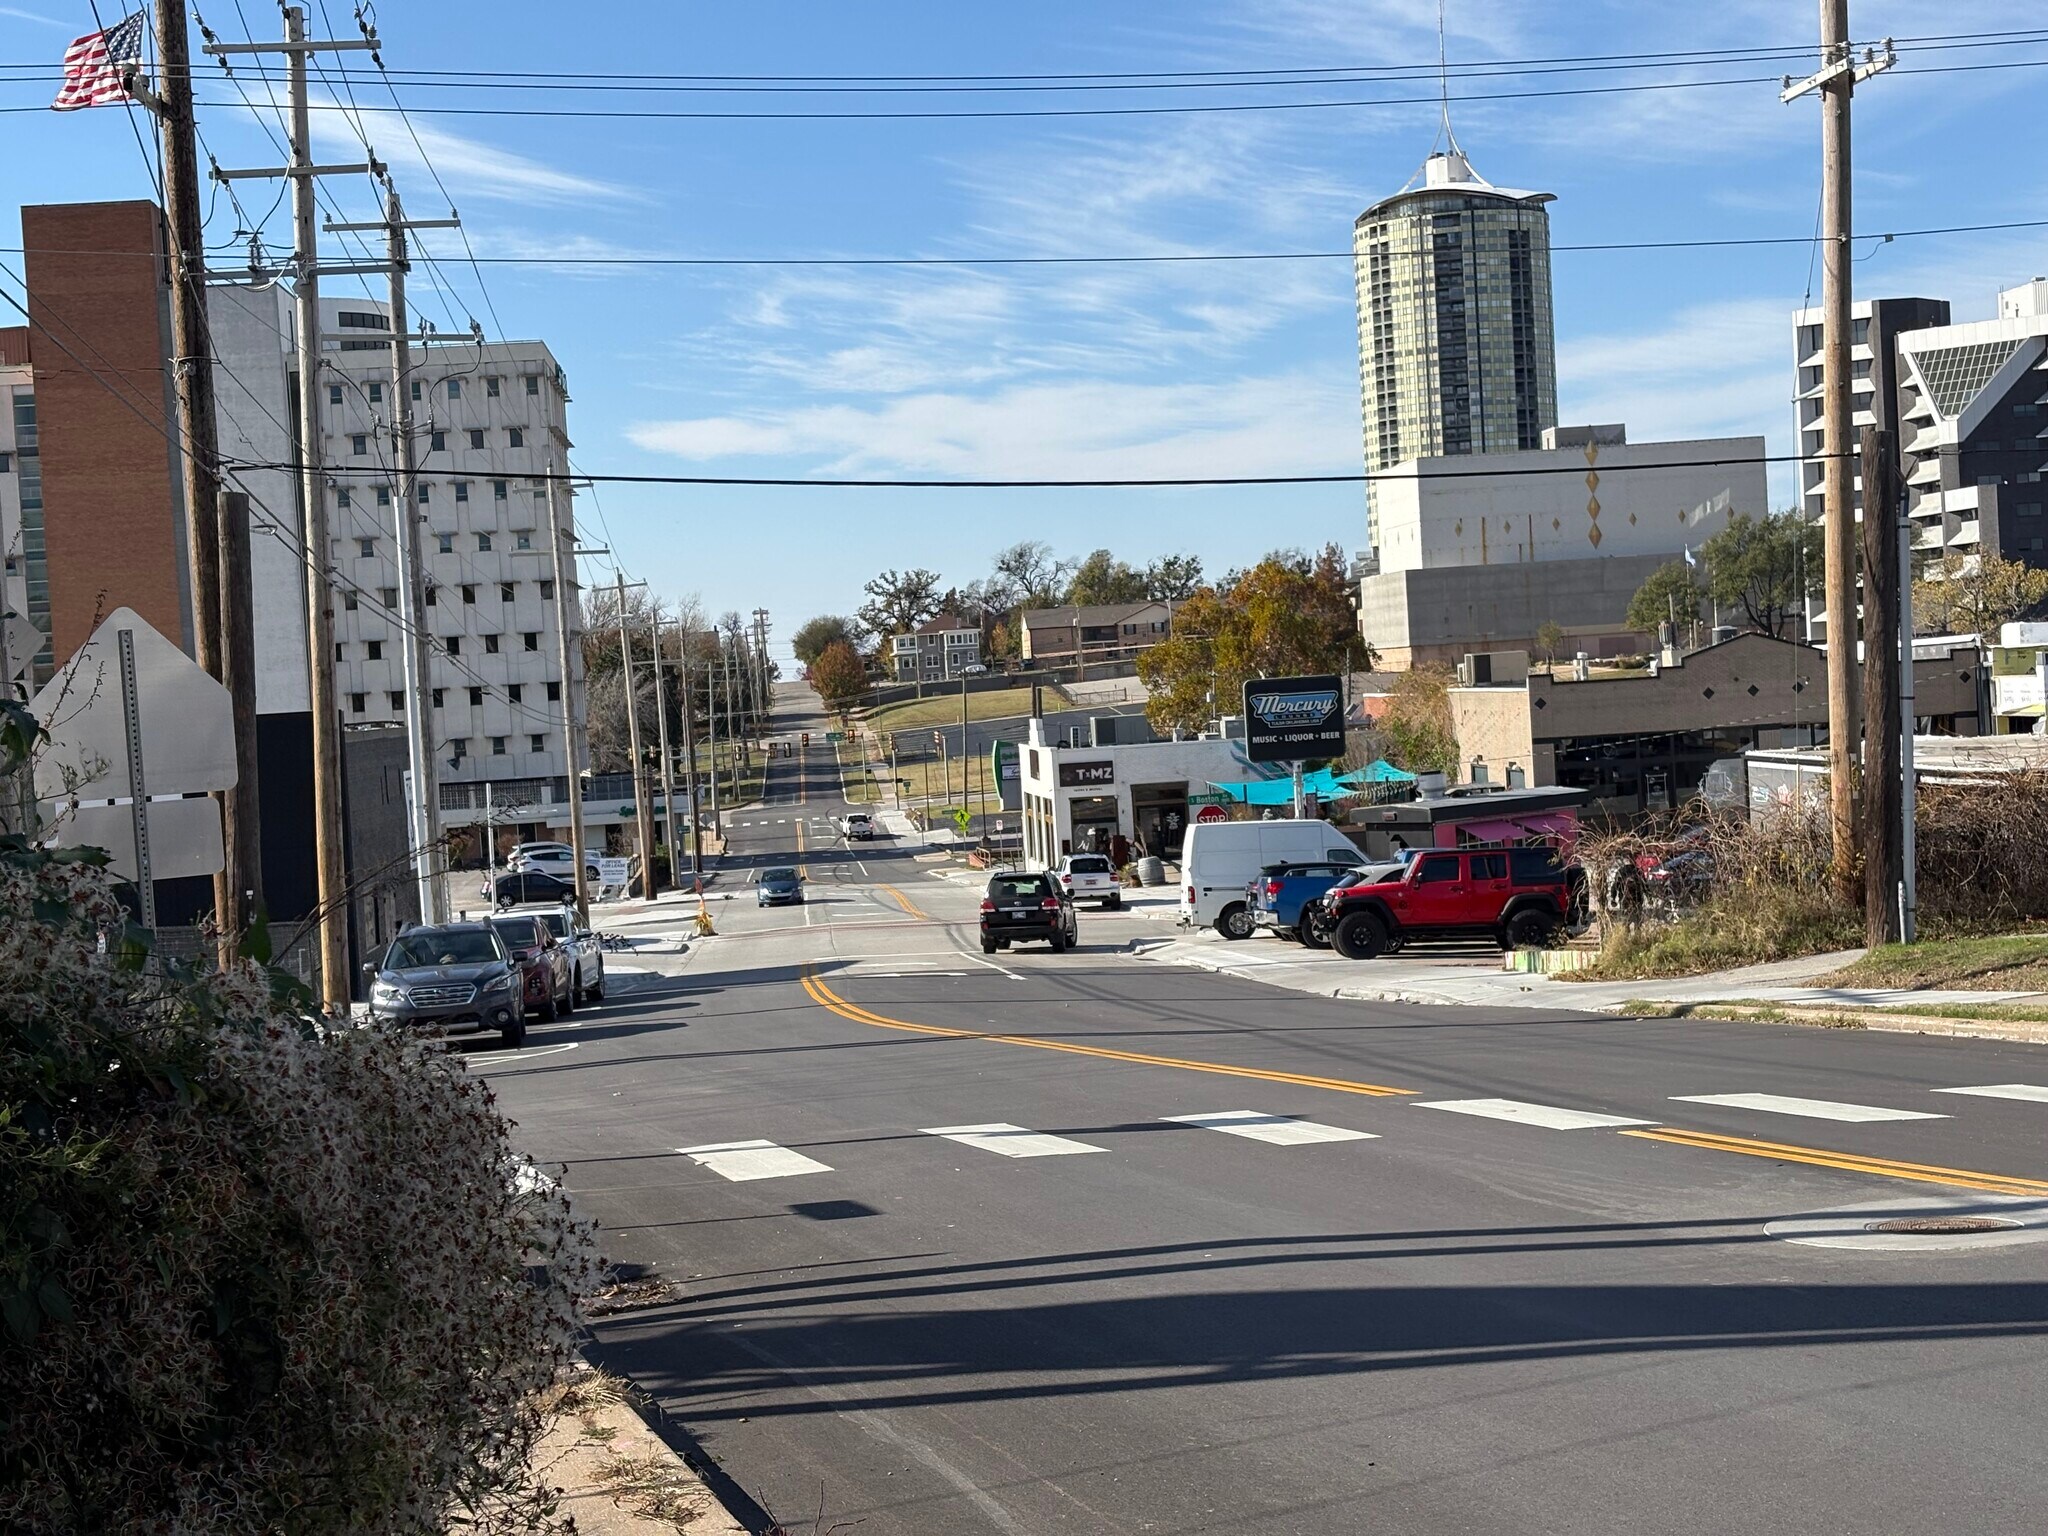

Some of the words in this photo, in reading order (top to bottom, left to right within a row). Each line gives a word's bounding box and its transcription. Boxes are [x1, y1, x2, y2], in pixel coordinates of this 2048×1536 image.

[1256, 695, 1334, 715] Mercury
[1252, 735, 1278, 744] MUSIC
[1284, 733, 1314, 742] LIQUOR
[1320, 731, 1340, 740] BEER
[1196, 796, 1220, 804] Boston
[1198, 814, 1226, 824] STOP
